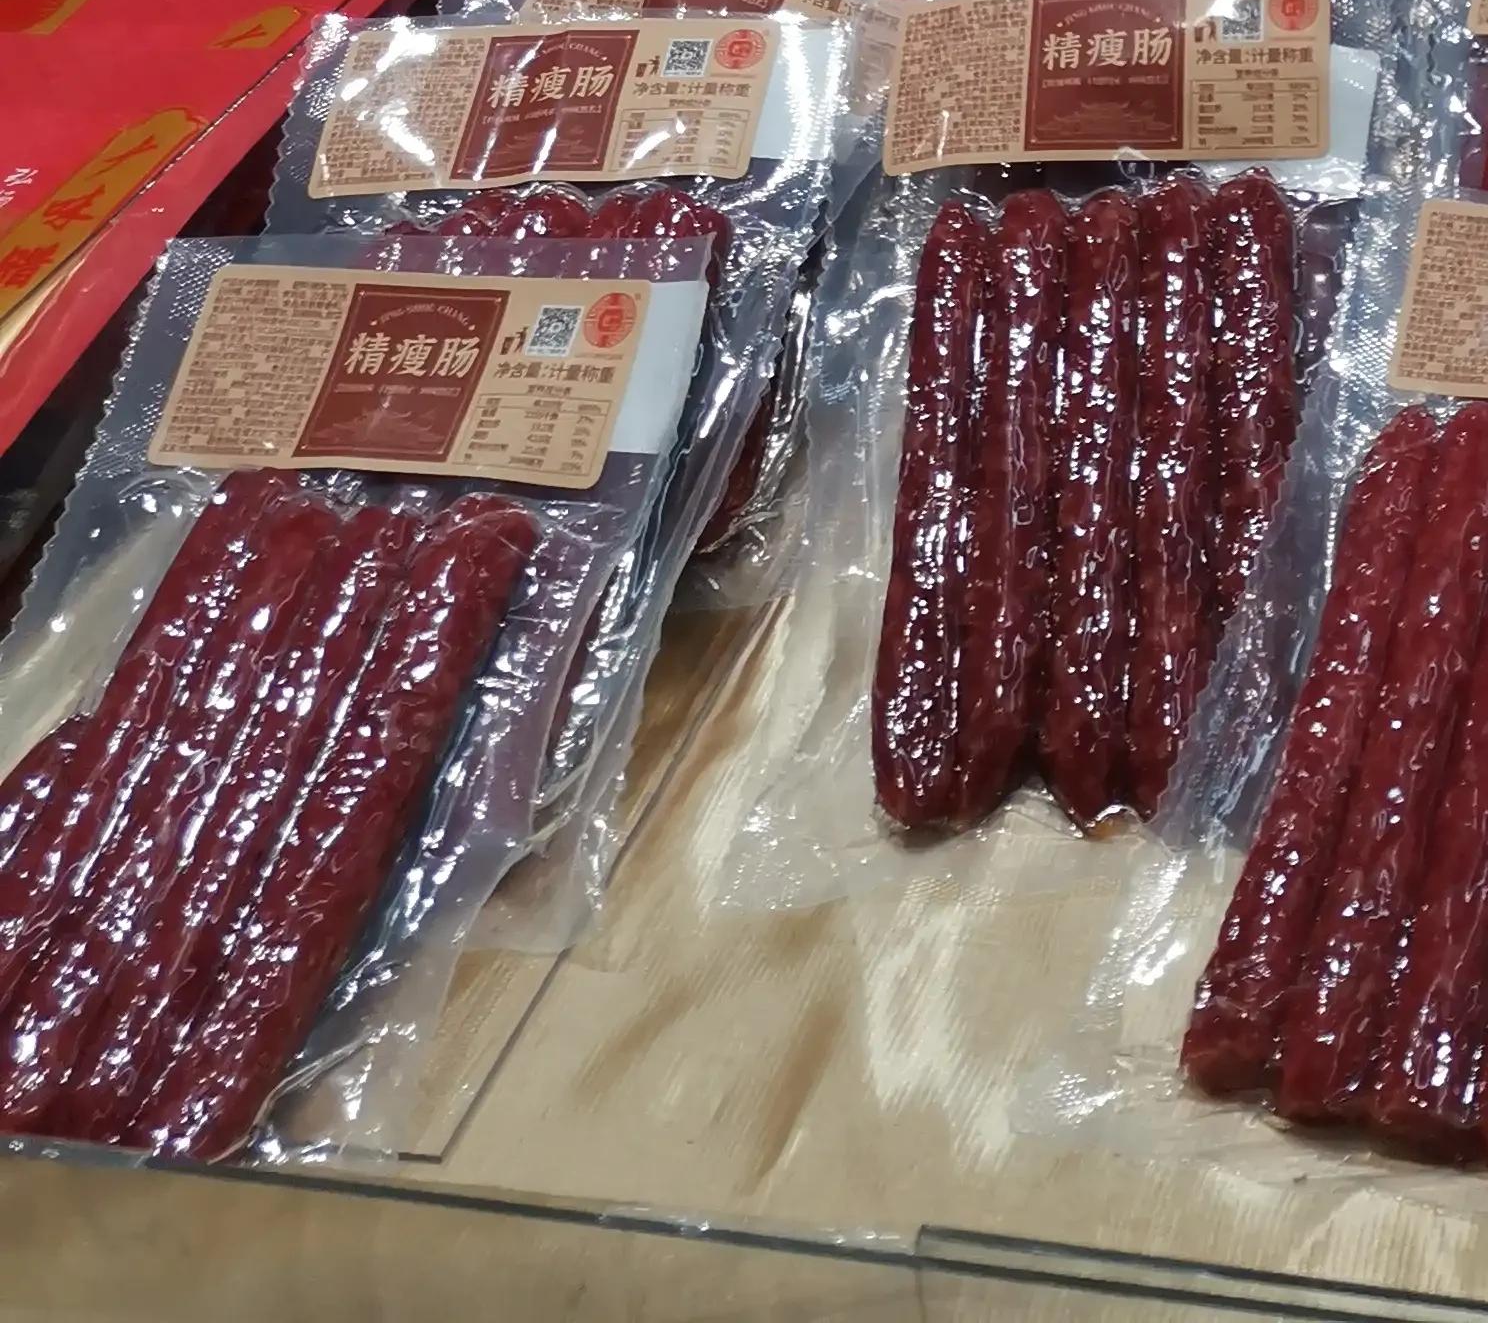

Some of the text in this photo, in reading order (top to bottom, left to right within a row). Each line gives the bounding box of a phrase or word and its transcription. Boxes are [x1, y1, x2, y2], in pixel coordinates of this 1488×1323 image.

[1041, 27, 1173, 72] 精瘦肠
[486, 63, 616, 110] 精瘦肠
[344, 332, 483, 379] 精瘦肠
